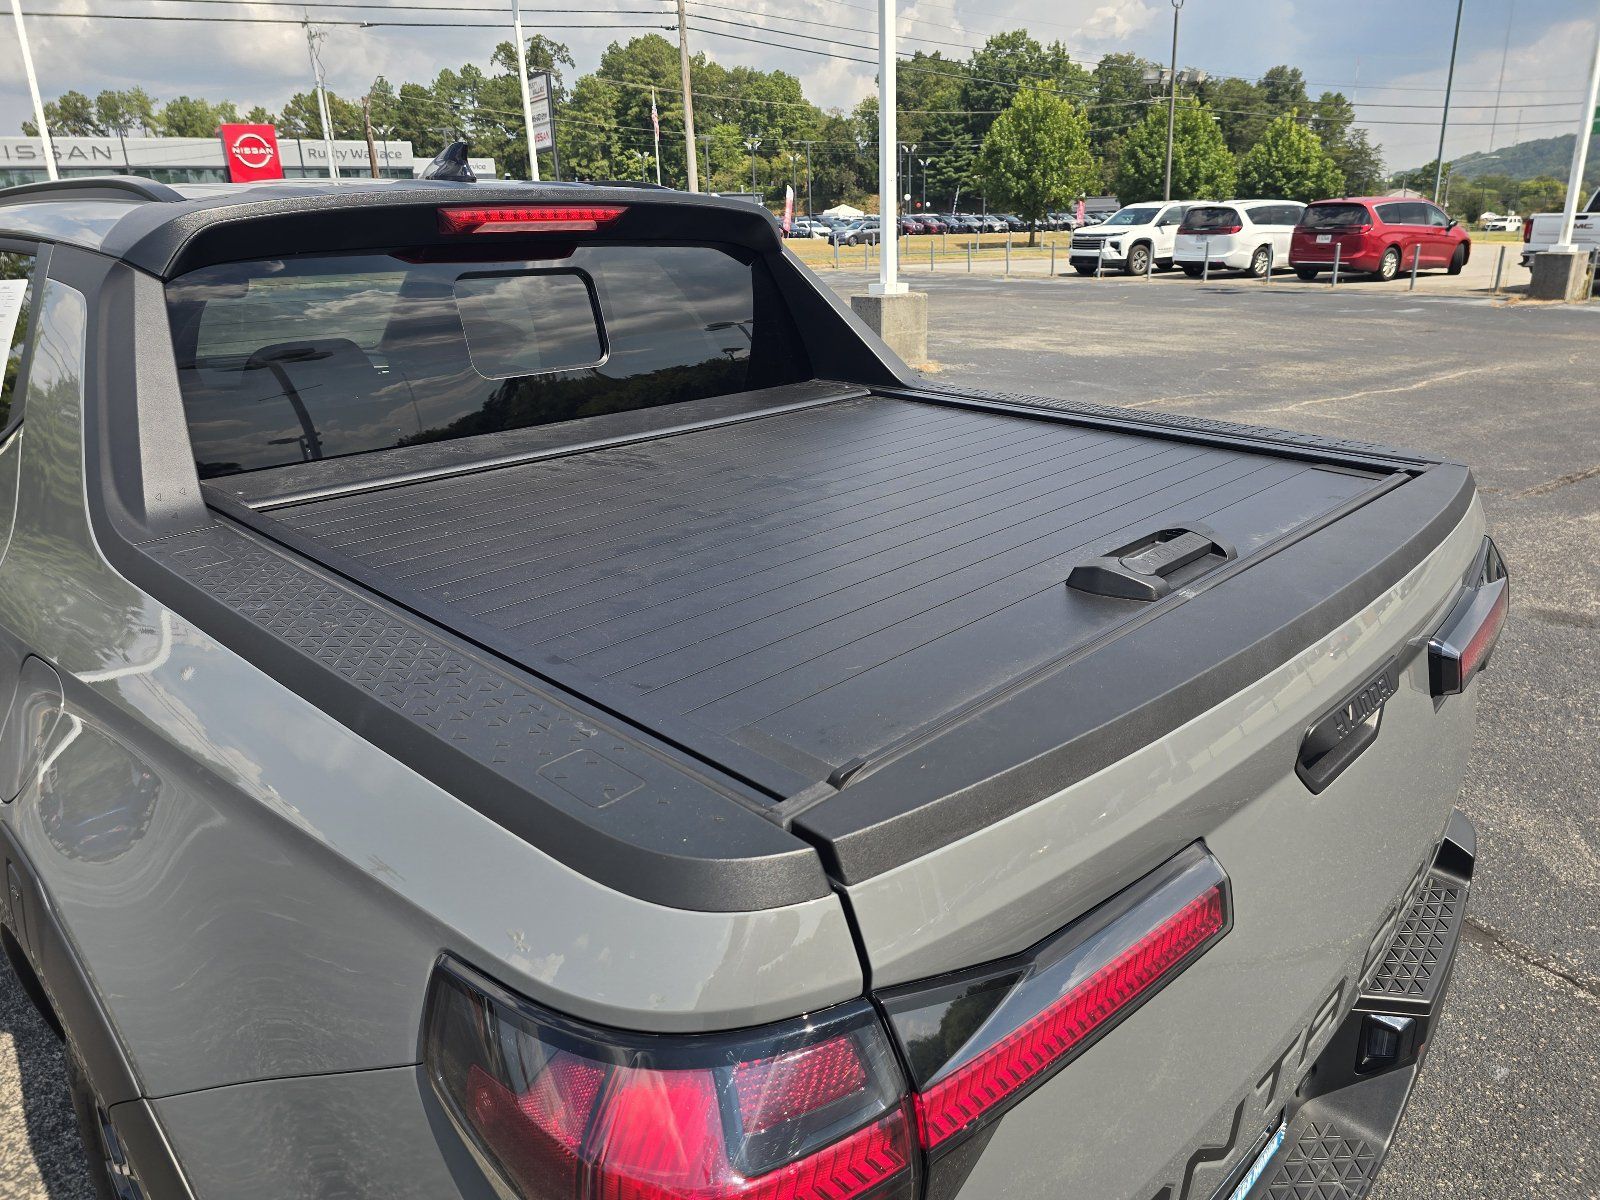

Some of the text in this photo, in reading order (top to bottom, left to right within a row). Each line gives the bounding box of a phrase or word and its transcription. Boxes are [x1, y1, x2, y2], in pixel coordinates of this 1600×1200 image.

[4, 145, 112, 160] ISSAN
[232, 146, 274, 155] NISSAN
[350, 148, 403, 159] Walace
[1333, 671, 1394, 739] HYUNDAI
